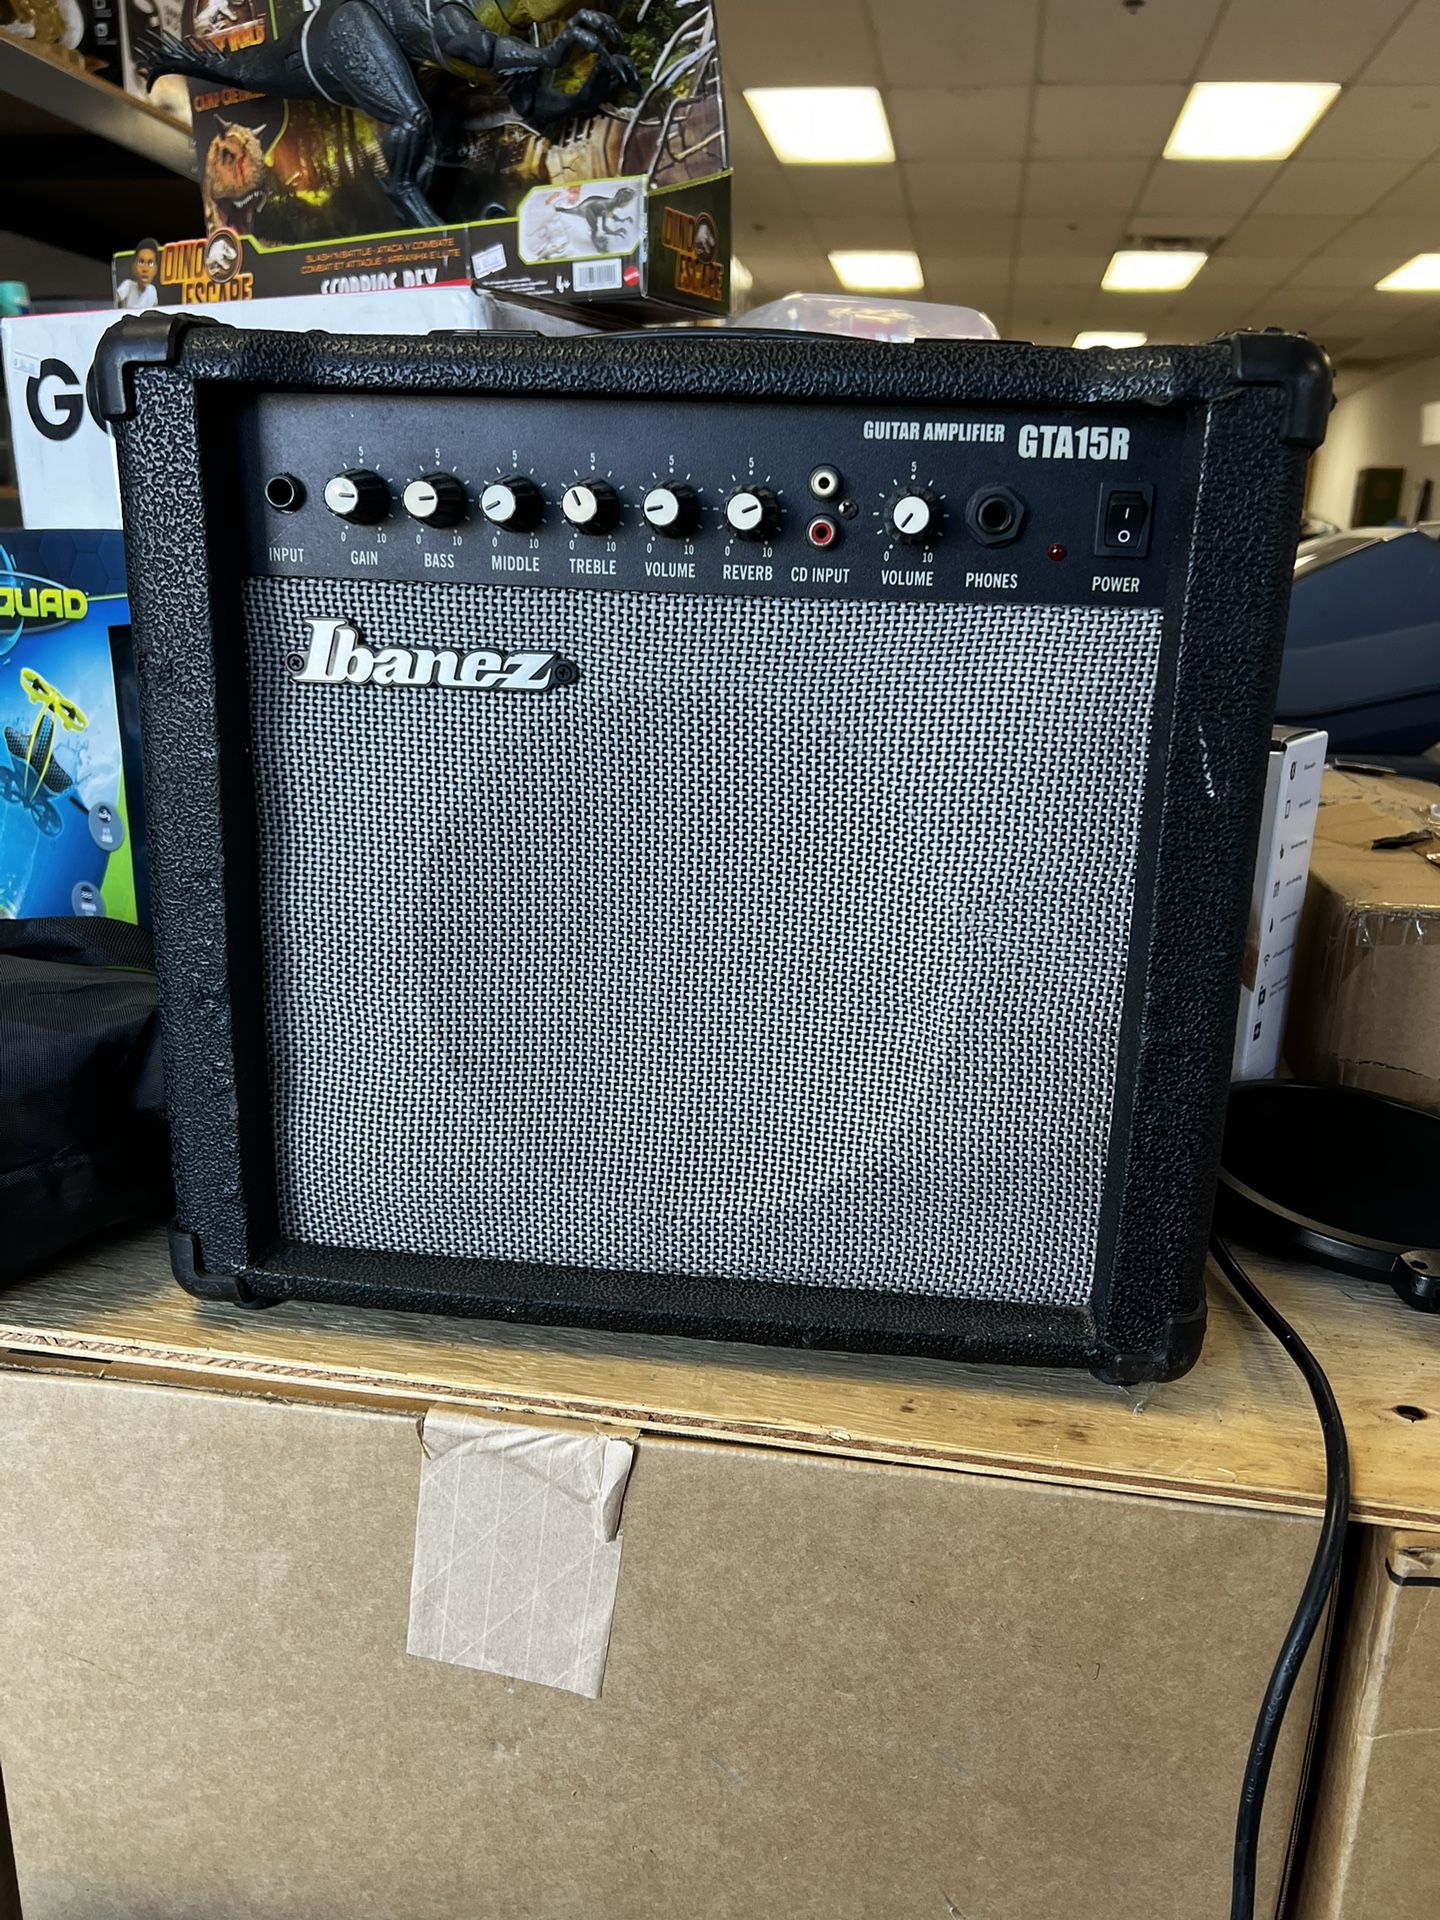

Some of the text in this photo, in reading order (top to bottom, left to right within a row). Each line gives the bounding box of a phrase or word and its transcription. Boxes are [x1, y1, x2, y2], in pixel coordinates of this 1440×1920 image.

[863, 420, 1130, 461] GUITAR AMPLIFIER GTA15R
[358, 445, 364, 457] 5
[434, 447, 441, 459] 5
[512, 449, 518, 461] 5
[590, 452, 596, 464] 5
[668, 454, 675, 466] 5
[748, 456, 755, 468] 5
[911, 461, 917, 473] 5
[340, 531, 387, 544] 0 10
[415, 534, 463, 546] 0 10
[491, 536, 539, 549] 0 10
[568, 539, 617, 553] 0 10
[646, 542, 695, 556] 0 10
[724, 545, 773, 558] 0 10
[269, 547, 305, 563] INPUT
[350, 550, 378, 566] GAIN
[424, 552, 455, 569] BASS
[883, 550, 934, 563] 0 10
[491, 554, 540, 572] MIDDLE
[568, 558, 617, 575] TREBLE
[644, 561, 696, 578] VOLUME
[722, 564, 773, 581] REVERB
[790, 566, 850, 584] CD INPUT
[881, 569, 934, 587] VOLUME
[965, 572, 1018, 589] PHONES
[1091, 576, 1140, 593] POWER
[292, 618, 554, 690] Ibanez
